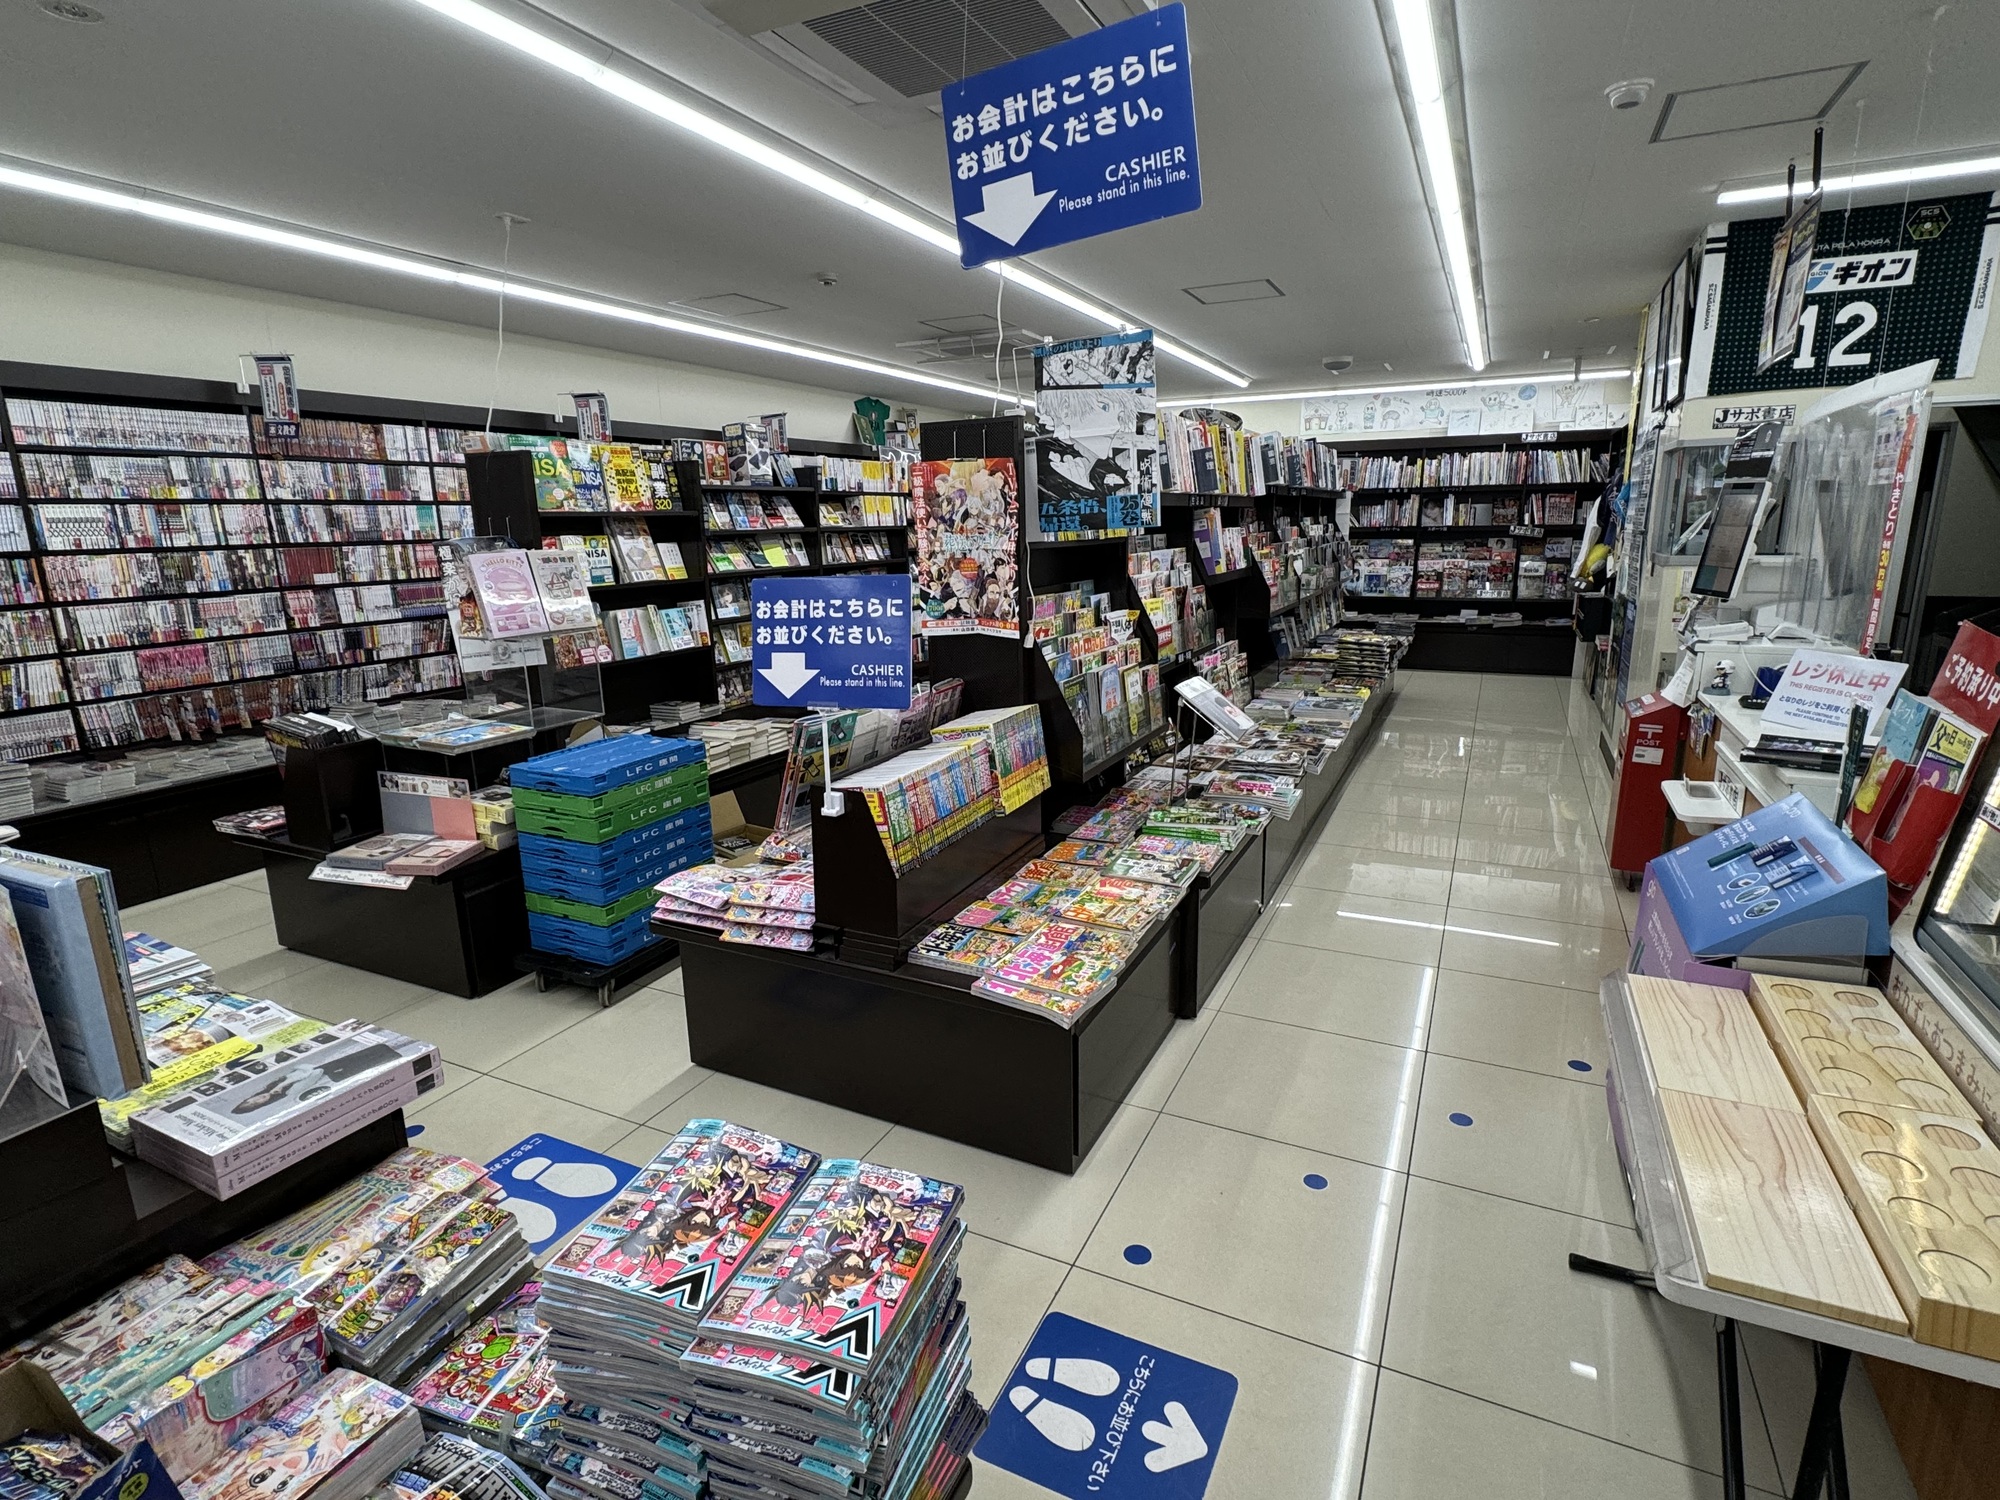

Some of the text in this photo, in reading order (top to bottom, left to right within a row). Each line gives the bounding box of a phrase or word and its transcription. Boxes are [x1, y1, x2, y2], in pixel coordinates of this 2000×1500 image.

[952, 44, 1177, 143] お会計はこちらに
[956, 97, 1164, 181] お並びください。
[1105, 145, 1187, 183] CASHIER
[1058, 168, 1190, 213] Please stand in this line.
[1832, 257, 1912, 286] ギオン
[1793, 301, 1879, 370] 12
[533, 458, 567, 476] ISA
[654, 499, 672, 511] 320
[1885, 471, 1905, 537] やきとり
[756, 598, 904, 619] お会計はこちらに
[756, 625, 892, 645] お並びください。
[851, 664, 904, 676] CASHIER
[1792, 660, 1891, 692] レジ休止中
[819, 676, 905, 688] Please stand in this line.
[1789, 681, 1803, 689] THIS
[1803, 684, 1836, 696] REGISTER
[1836, 689, 1844, 697] IS
[1636, 738, 1662, 746] POST
[626, 762, 654, 777] LFC
[635, 783, 652, 796] LFC
[630, 805, 657, 821] LFC
[632, 828, 660, 844] LFC
[635, 847, 662, 864] LFC
[636, 867, 663, 884] LFC
[587, 1269, 632, 1289] ブイジャンプ
[649, 1262, 715, 1311] V
[745, 1320, 793, 1339] ブイジャンプ
[806, 1307, 874, 1361] V
[725, 1354, 772, 1373] ブイジャンプ
[1087, 1354, 1155, 1491] こちらにお並び下さい
